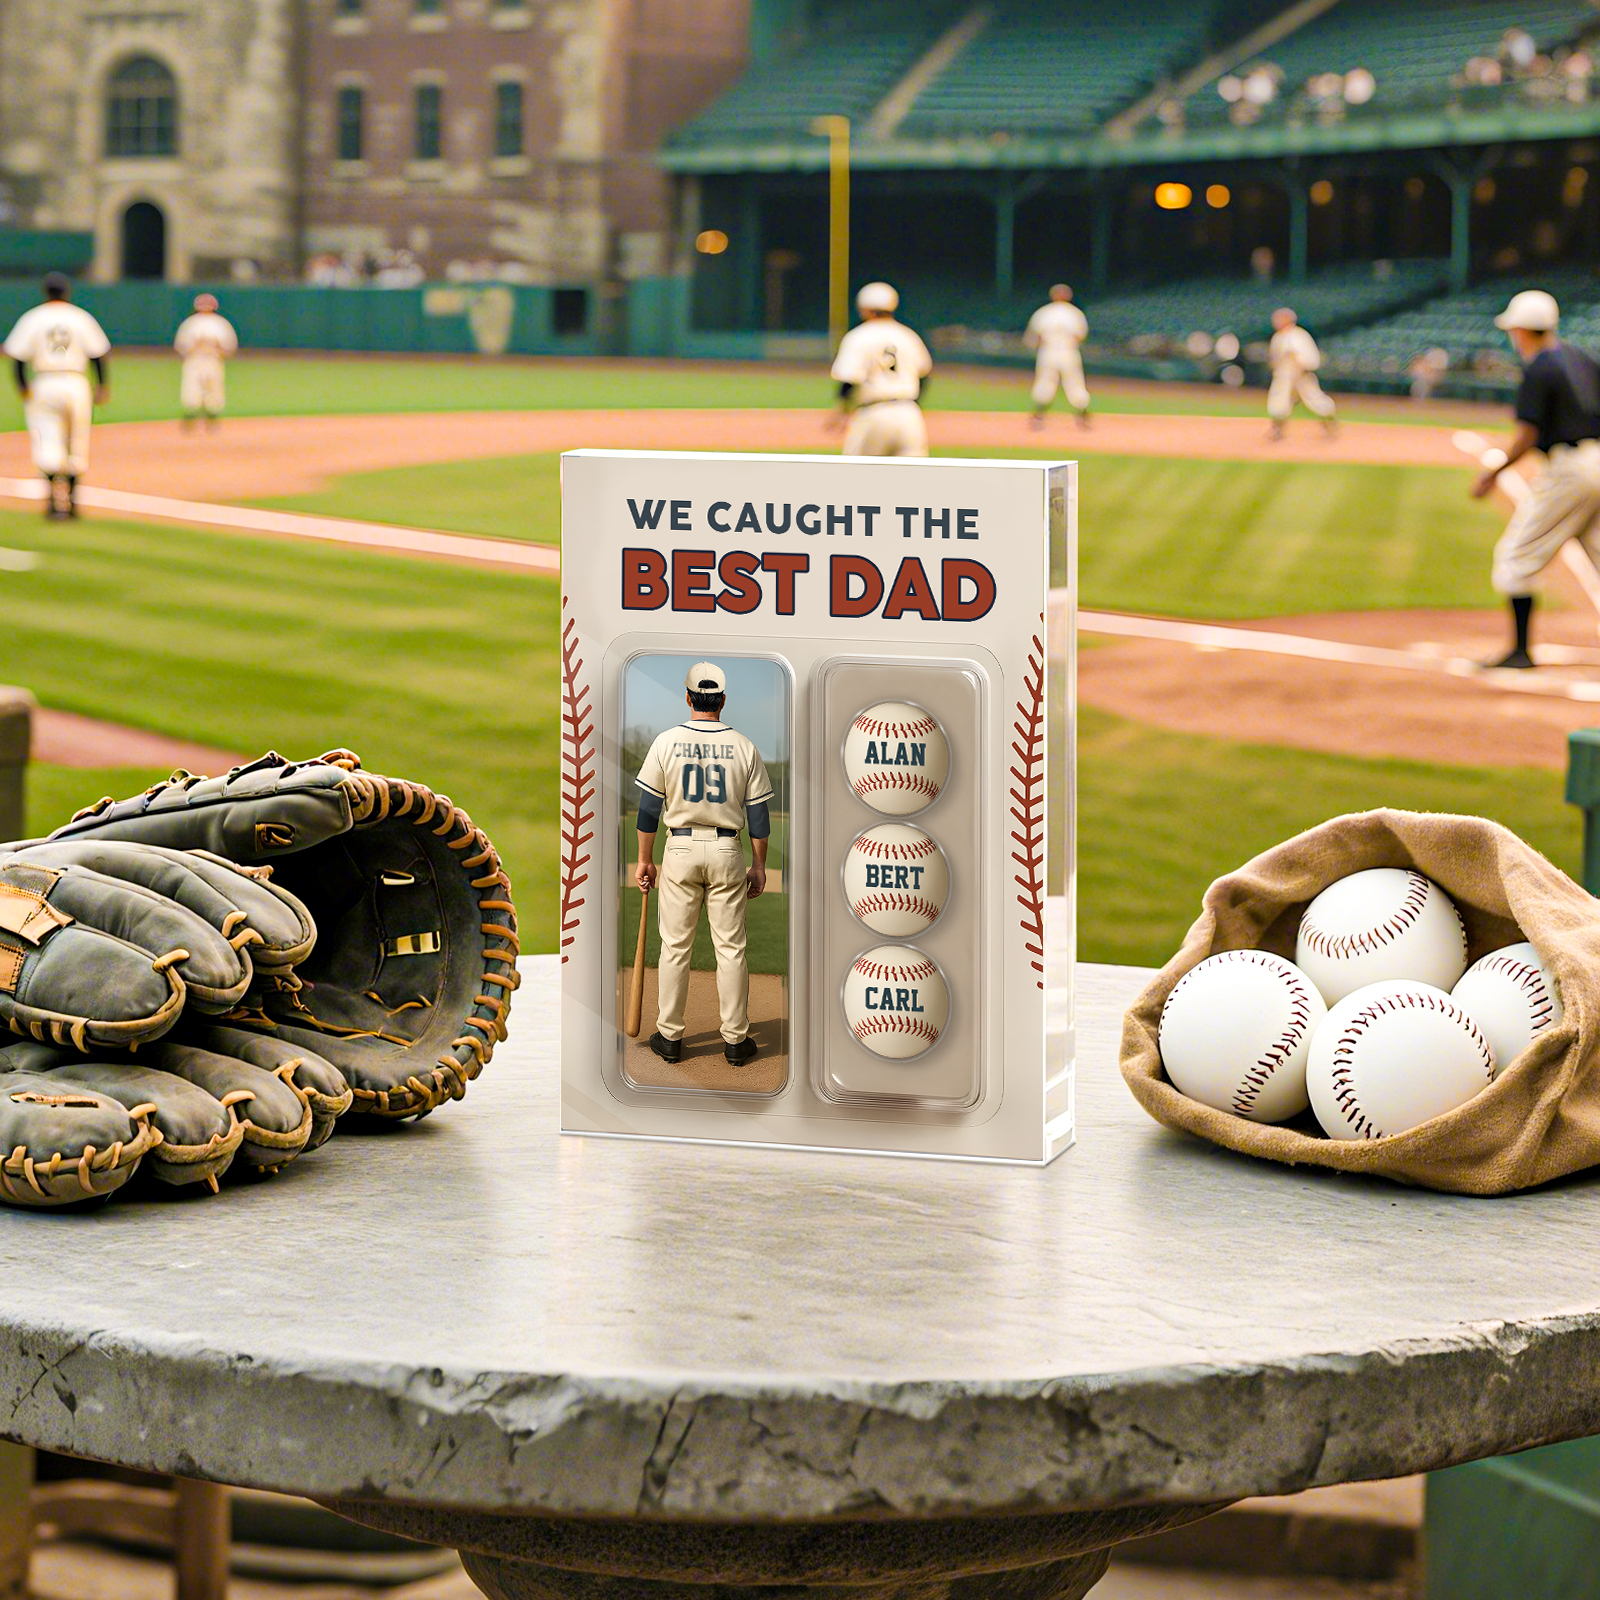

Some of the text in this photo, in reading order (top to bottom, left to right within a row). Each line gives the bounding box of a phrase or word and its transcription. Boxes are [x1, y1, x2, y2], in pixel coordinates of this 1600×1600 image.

[626, 499, 979, 540] WE CAUGHT THE
[621, 547, 997, 622] BEST DAD
[674, 742, 734, 760] CHARLIE
[864, 741, 927, 767] ALAN
[682, 763, 727, 804] 09
[865, 863, 925, 890] BERT
[864, 986, 925, 1013] CARL
